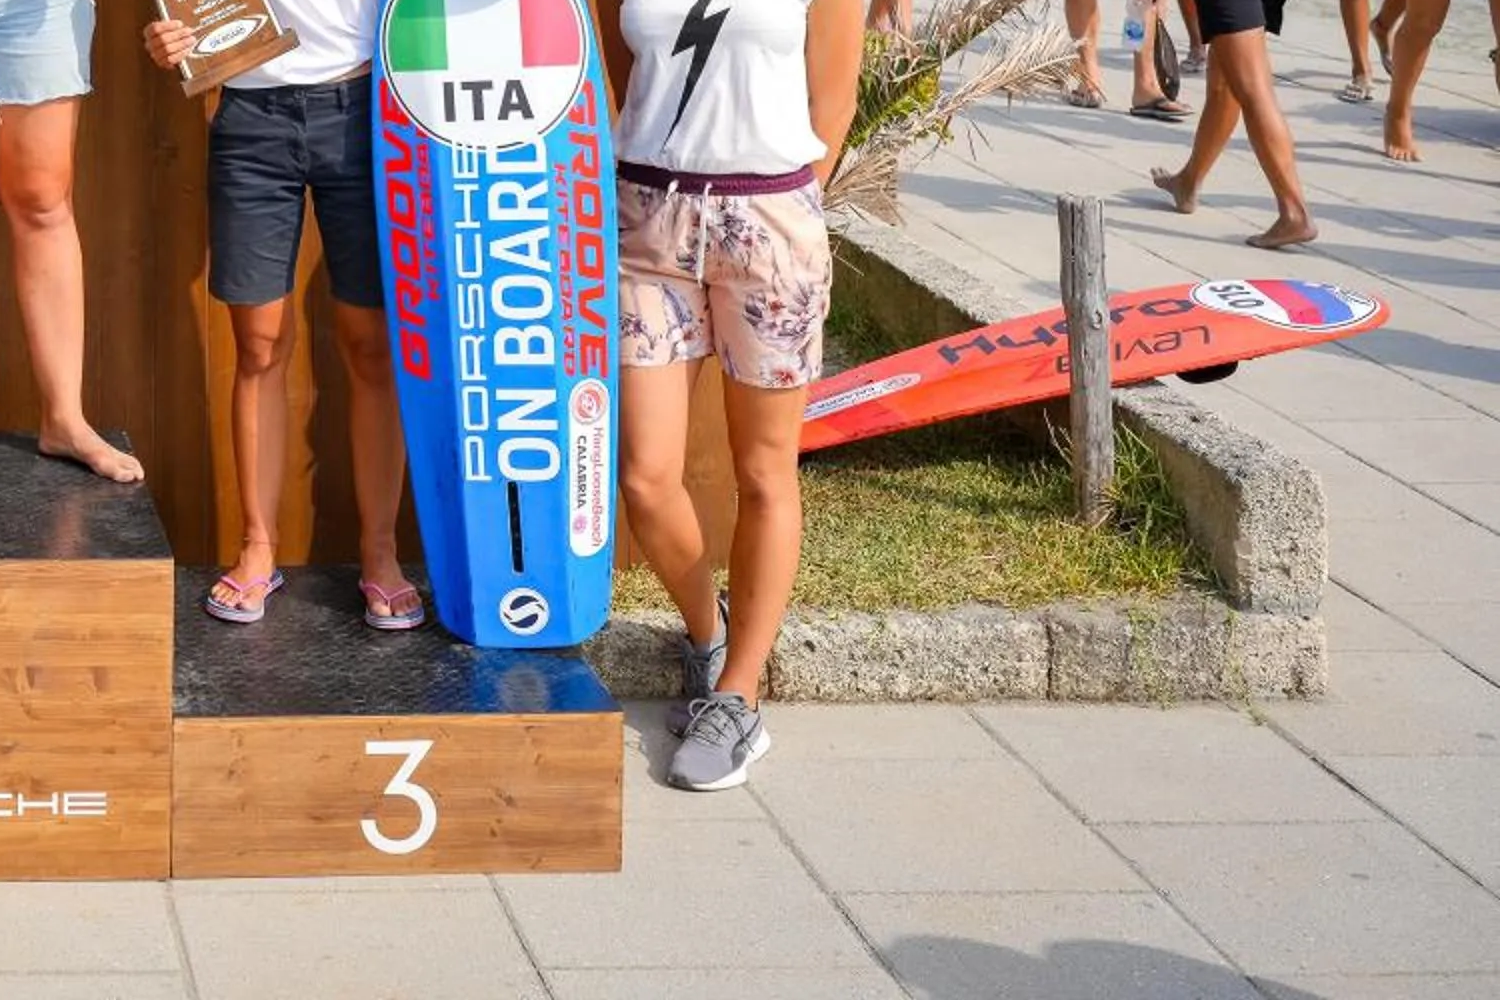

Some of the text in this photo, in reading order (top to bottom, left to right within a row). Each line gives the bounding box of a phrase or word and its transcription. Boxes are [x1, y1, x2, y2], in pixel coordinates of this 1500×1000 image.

[443, 79, 535, 122] ITA
[452, 142, 493, 482] PORSCHE
[485, 136, 561, 483] ON BOARD
[554, 163, 577, 378] KITEBOARD
[567, 80, 609, 379] GROOVE
[1208, 283, 1265, 309] SLO
[577, 435, 587, 509] CALABRIA
[360, 740, 438, 856] 3
